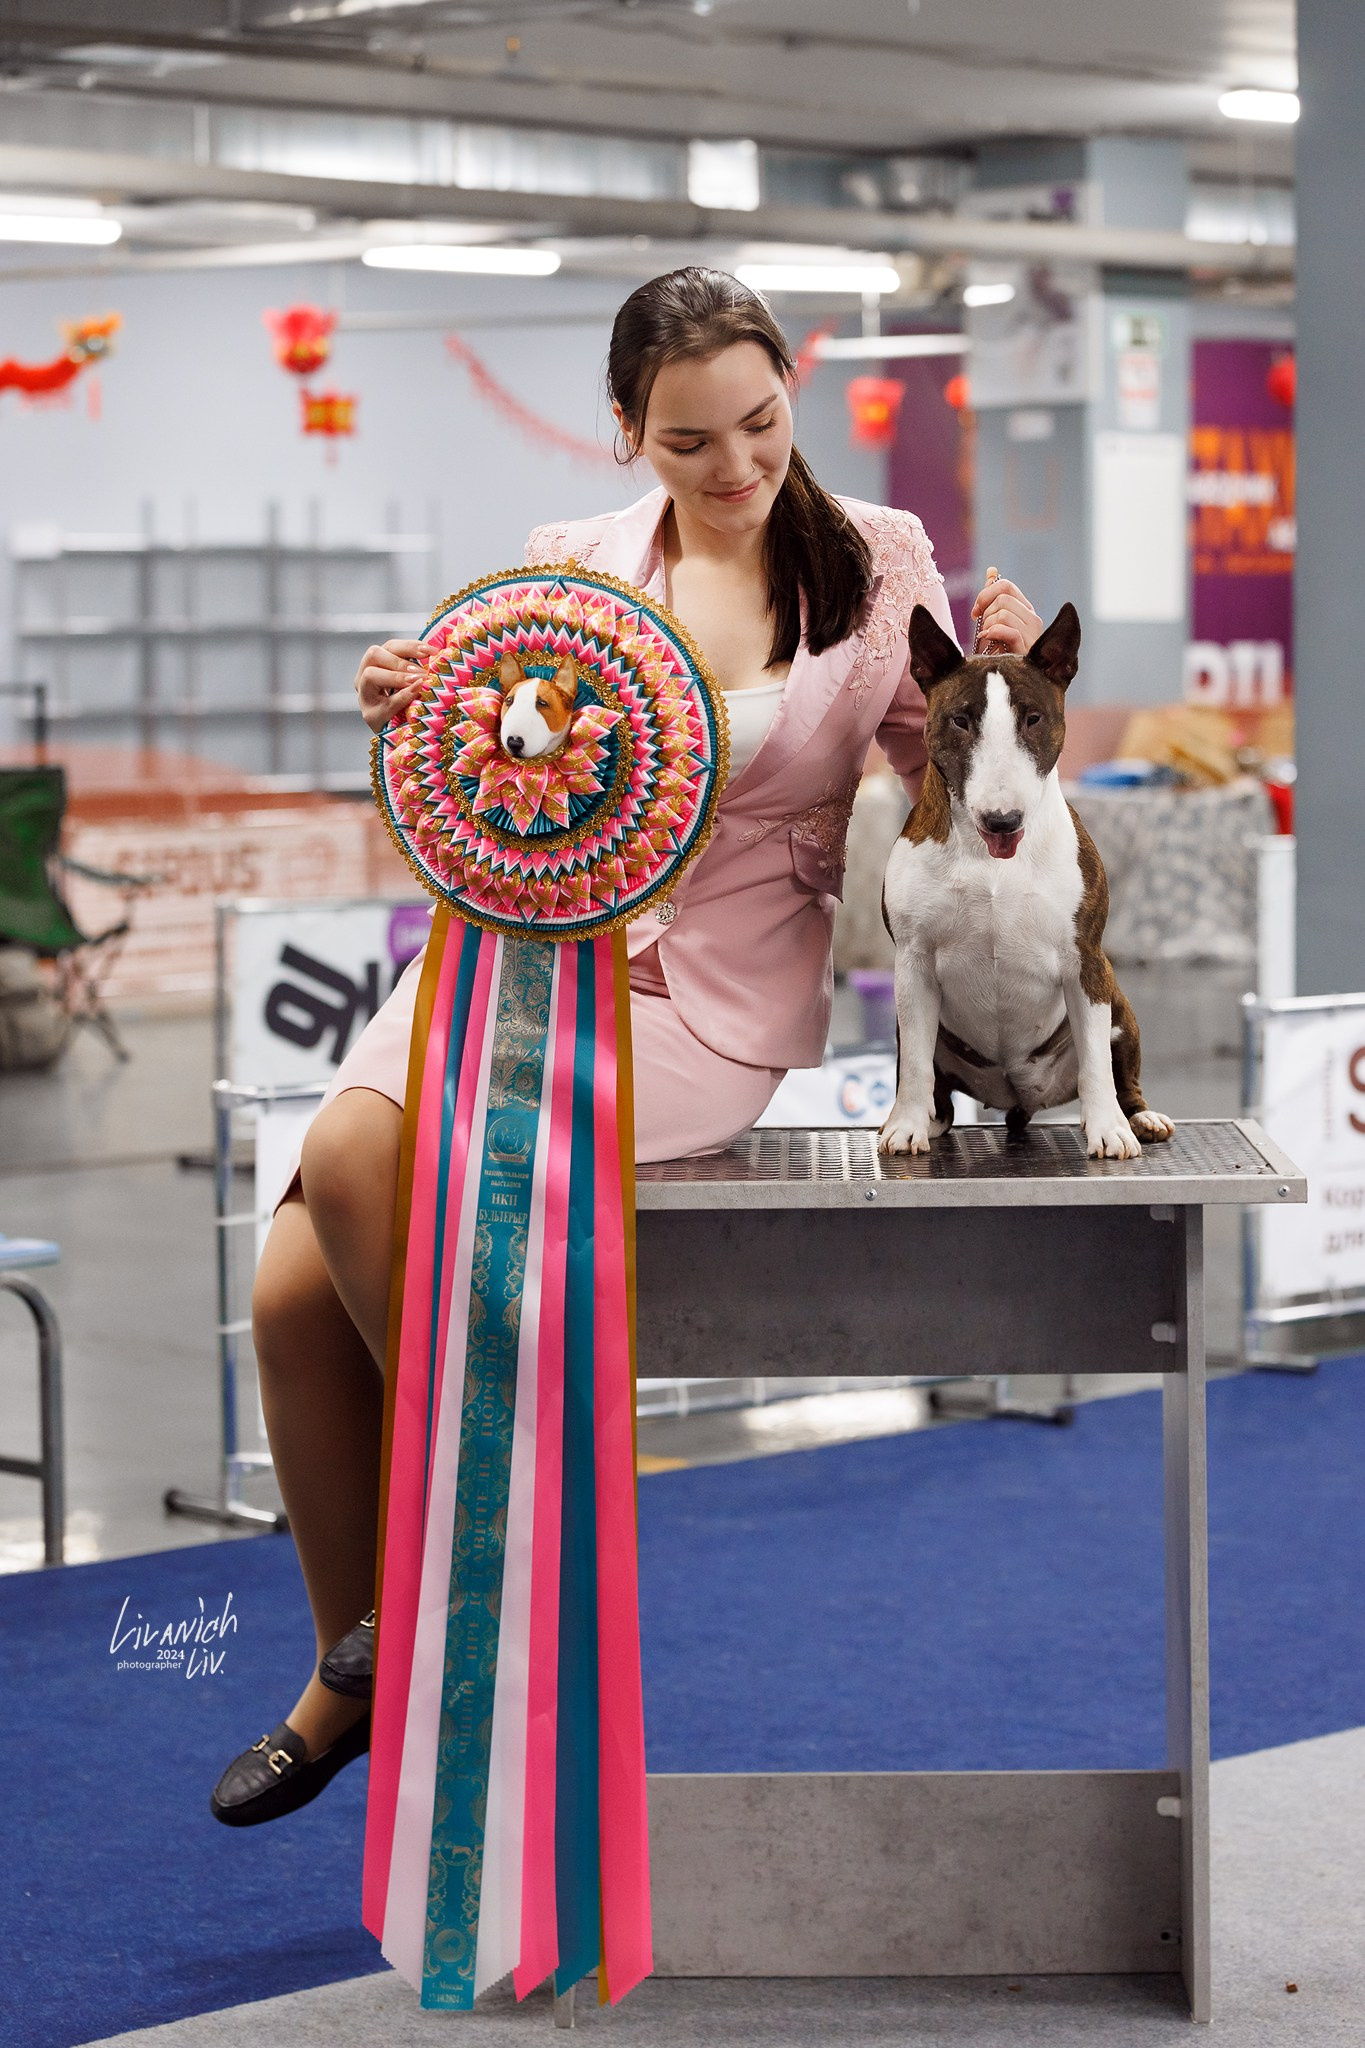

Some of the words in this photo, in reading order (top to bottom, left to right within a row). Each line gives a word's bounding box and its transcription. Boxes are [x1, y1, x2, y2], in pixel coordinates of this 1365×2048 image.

[491, 1192, 518, 1207] НКП
[478, 1208, 528, 1225] БУЛЬТЕРЬЕР
[481, 1334, 499, 1437] ПОРОДЫ
